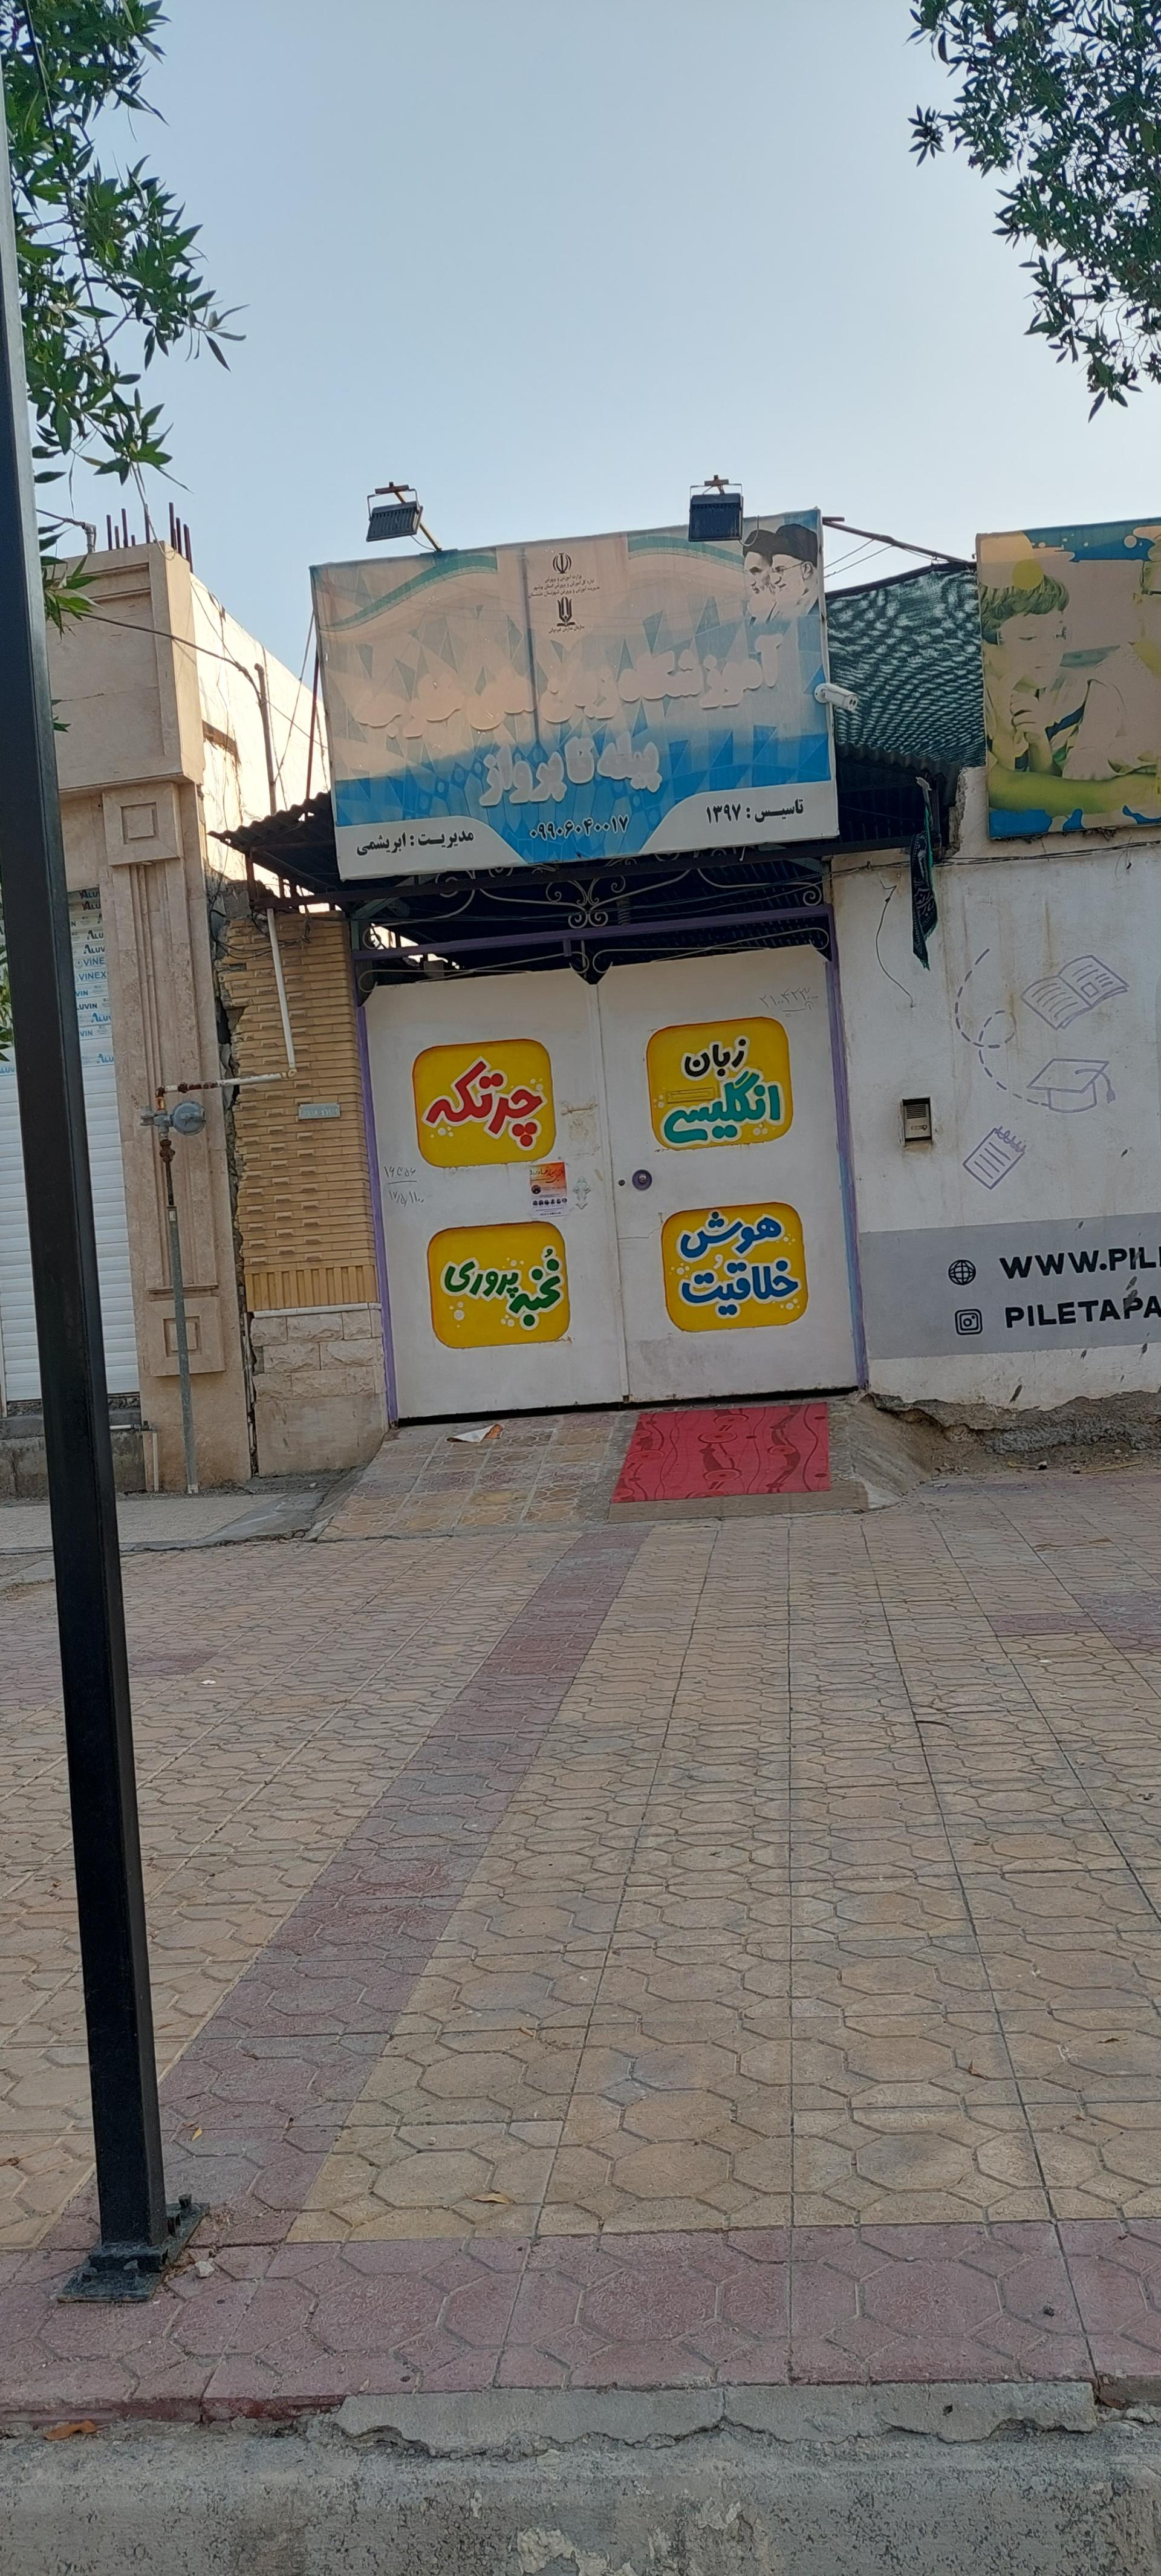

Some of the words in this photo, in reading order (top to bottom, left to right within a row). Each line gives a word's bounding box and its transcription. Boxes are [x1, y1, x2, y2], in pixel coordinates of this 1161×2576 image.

[479, 742, 567, 807] پرواز
[565, 736, 594, 784] تا
[596, 731, 663, 793] پیله
[530, 816, 629, 841] ۰۹۹۰۶۰۴۰۰۱۷
[706, 803, 741, 824] ۱۳۹۷
[755, 798, 804, 823] تاسیس
[357, 831, 406, 856] ابریشمی
[417, 830, 475, 849] مدیریت
[683, 1038, 747, 1078] زبان
[424, 1059, 543, 1148] چرتکه
[663, 1070, 782, 1142] انگلیسی
[679, 1210, 782, 1259] هوش
[446, 1260, 519, 1299] پروری
[998, 1246, 1161, 1280] WWW.PIL
[680, 1258, 799, 1316] خلاقیت
[1004, 1295, 1161, 1329] PILETAPA
